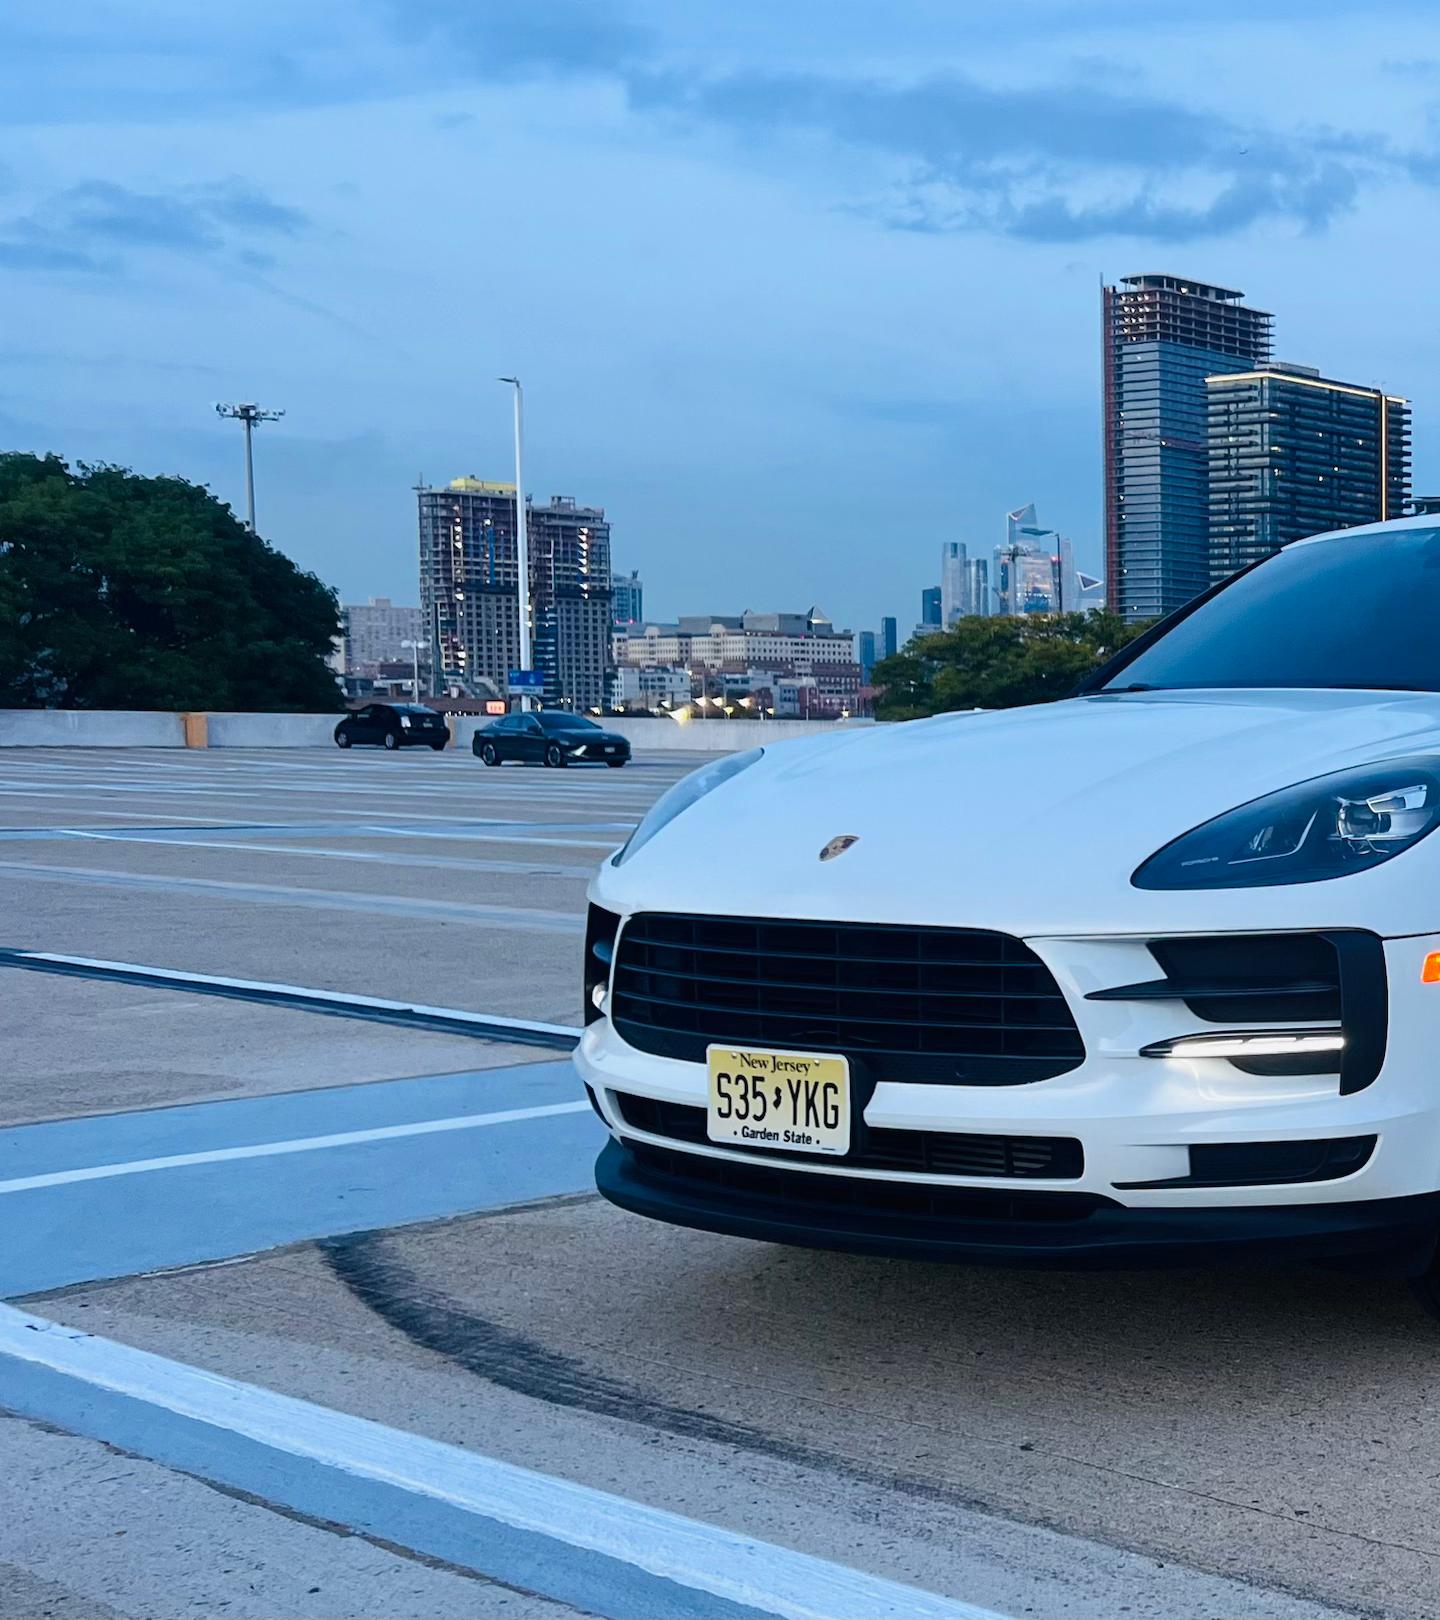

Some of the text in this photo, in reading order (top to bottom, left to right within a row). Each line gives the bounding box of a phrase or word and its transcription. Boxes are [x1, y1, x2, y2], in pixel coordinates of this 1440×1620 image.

[740, 1053, 811, 1076] New Jersey
[716, 1072, 839, 1129] S35 YKG
[741, 1125, 812, 1145] Garden State
